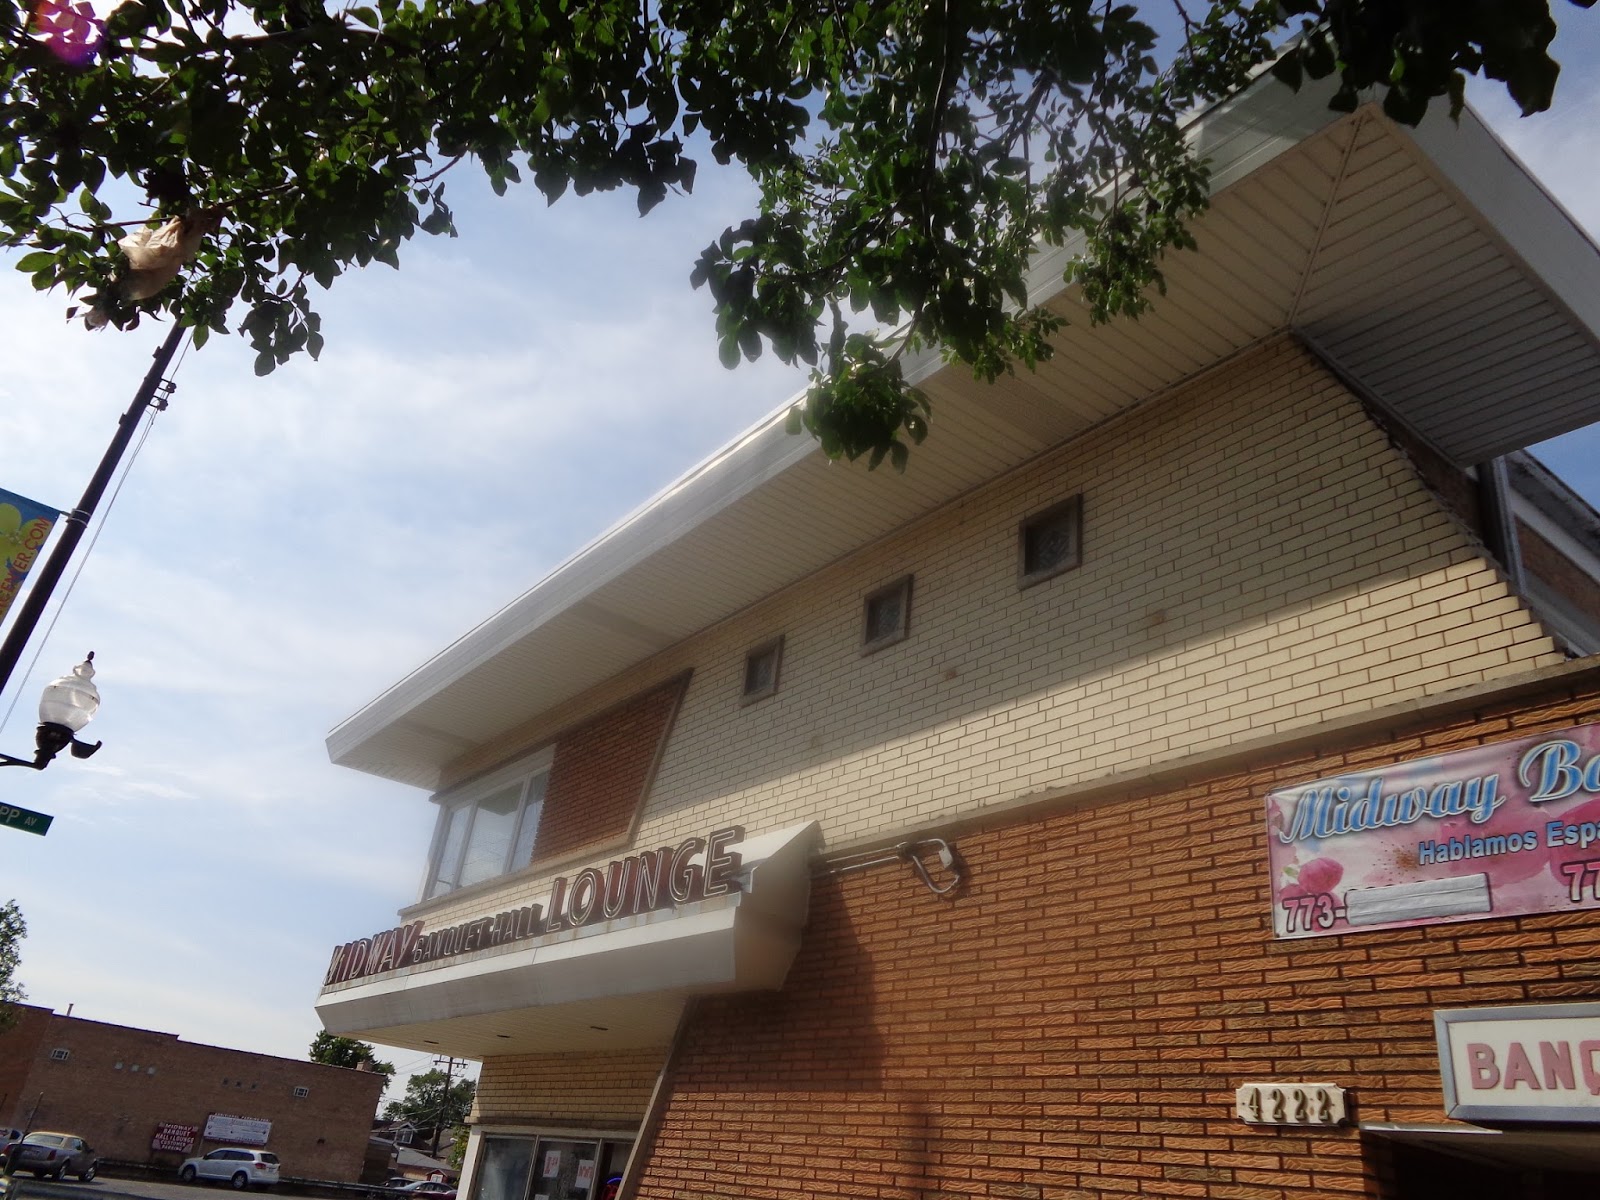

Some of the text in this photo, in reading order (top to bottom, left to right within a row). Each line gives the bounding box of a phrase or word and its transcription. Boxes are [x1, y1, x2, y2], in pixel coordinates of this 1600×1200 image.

[1280, 774, 1505, 844] Midway
[1418, 829, 1537, 866] Hablamos
[323, 825, 746, 988] MIDWAY BANQUET HALL LOUNGE
[1248, 1087, 1333, 1122] 4222
[163, 1128, 191, 1137] BANQUET
[165, 1123, 192, 1131] MIDWAY
